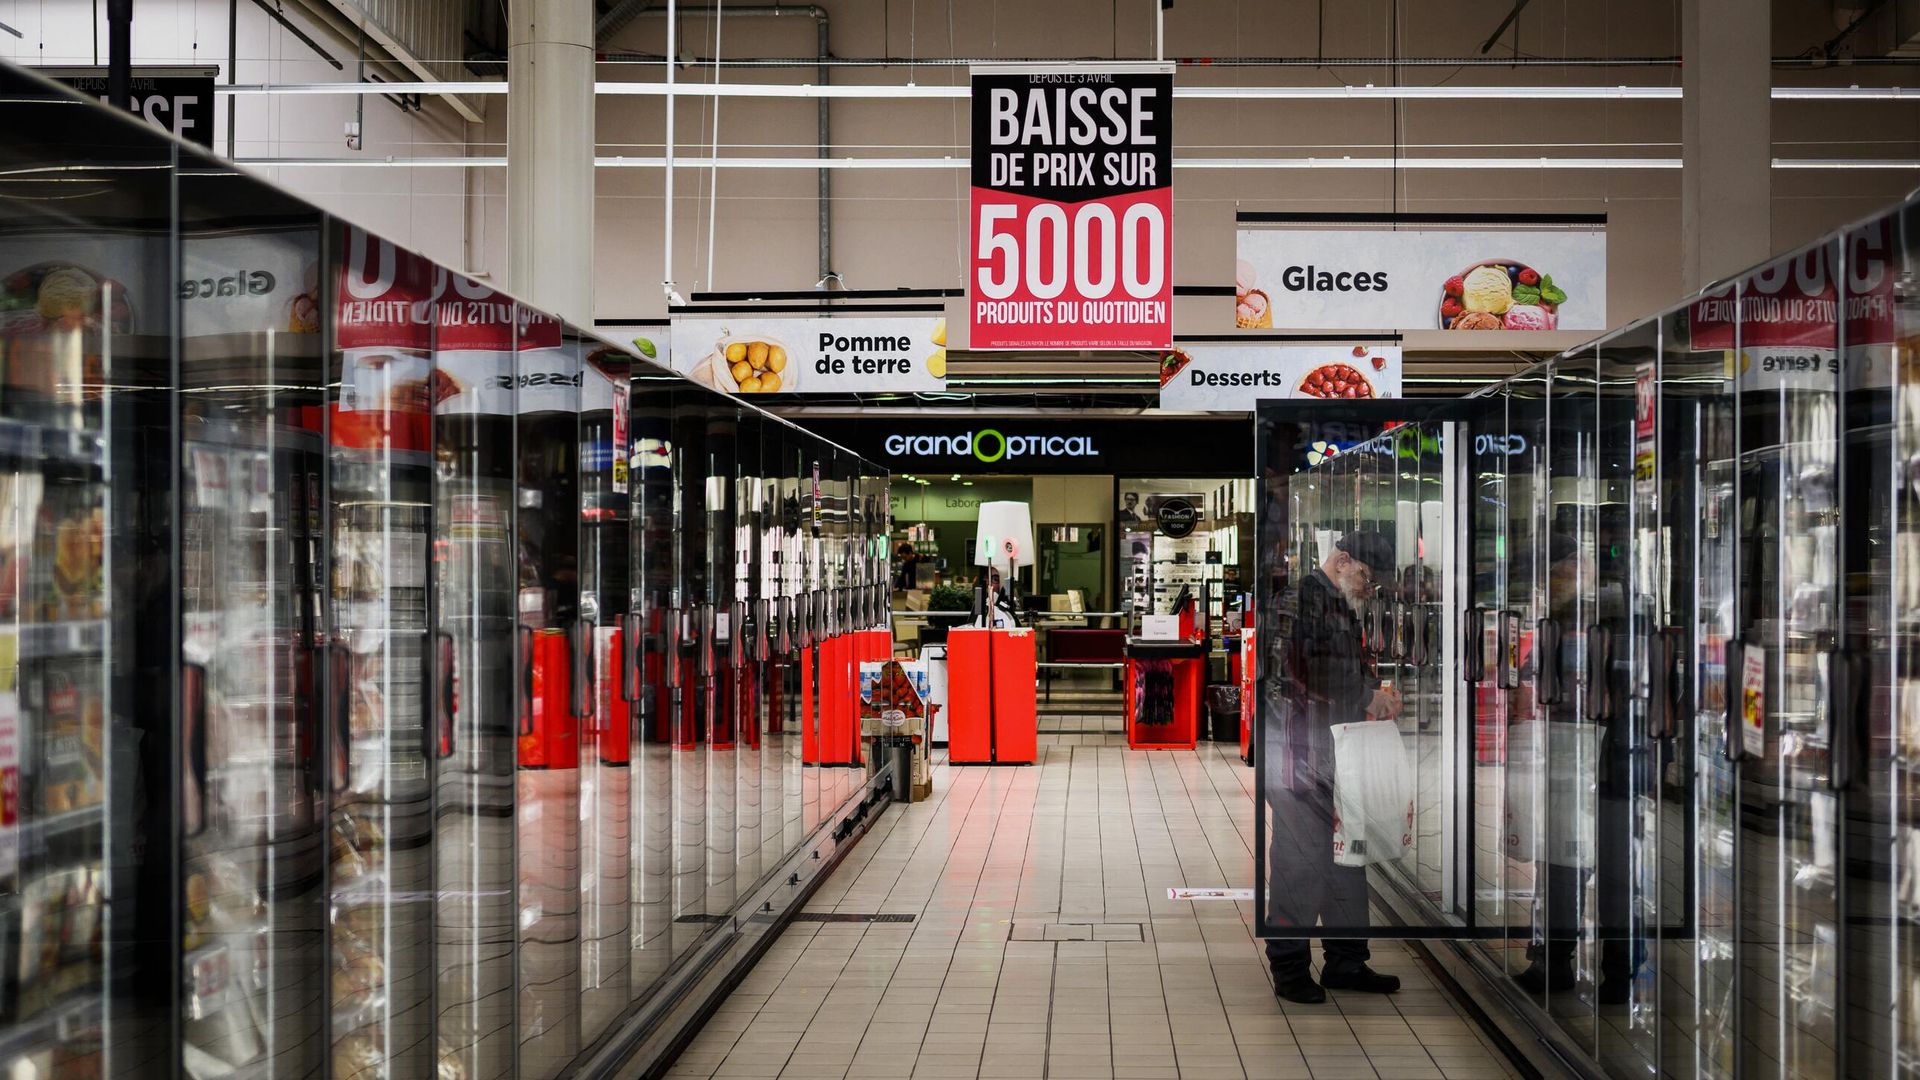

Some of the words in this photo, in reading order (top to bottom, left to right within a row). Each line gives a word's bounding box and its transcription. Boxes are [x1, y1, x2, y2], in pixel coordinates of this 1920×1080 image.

[1029, 74, 1062, 84] DEPUIS
[1064, 74, 1076, 84] LE
[1077, 74, 1084, 84] 3
[1087, 74, 1115, 84] AVRIL
[990, 87, 1157, 146] BAISSE
[990, 152, 1025, 187] DE
[1033, 152, 1096, 187] PRIX
[1103, 152, 1157, 187] SUR
[977, 202, 1165, 300] 5000
[1282, 265, 1389, 292] Glaces
[976, 301, 1054, 324] PRODUITS
[1057, 301, 1079, 324] DU
[1082, 301, 1166, 325] QUOTIDIEN
[819, 332, 911, 352] Pomme
[815, 355, 845, 374] de
[852, 355, 911, 374] terre
[1191, 370, 1282, 386] Desserts
